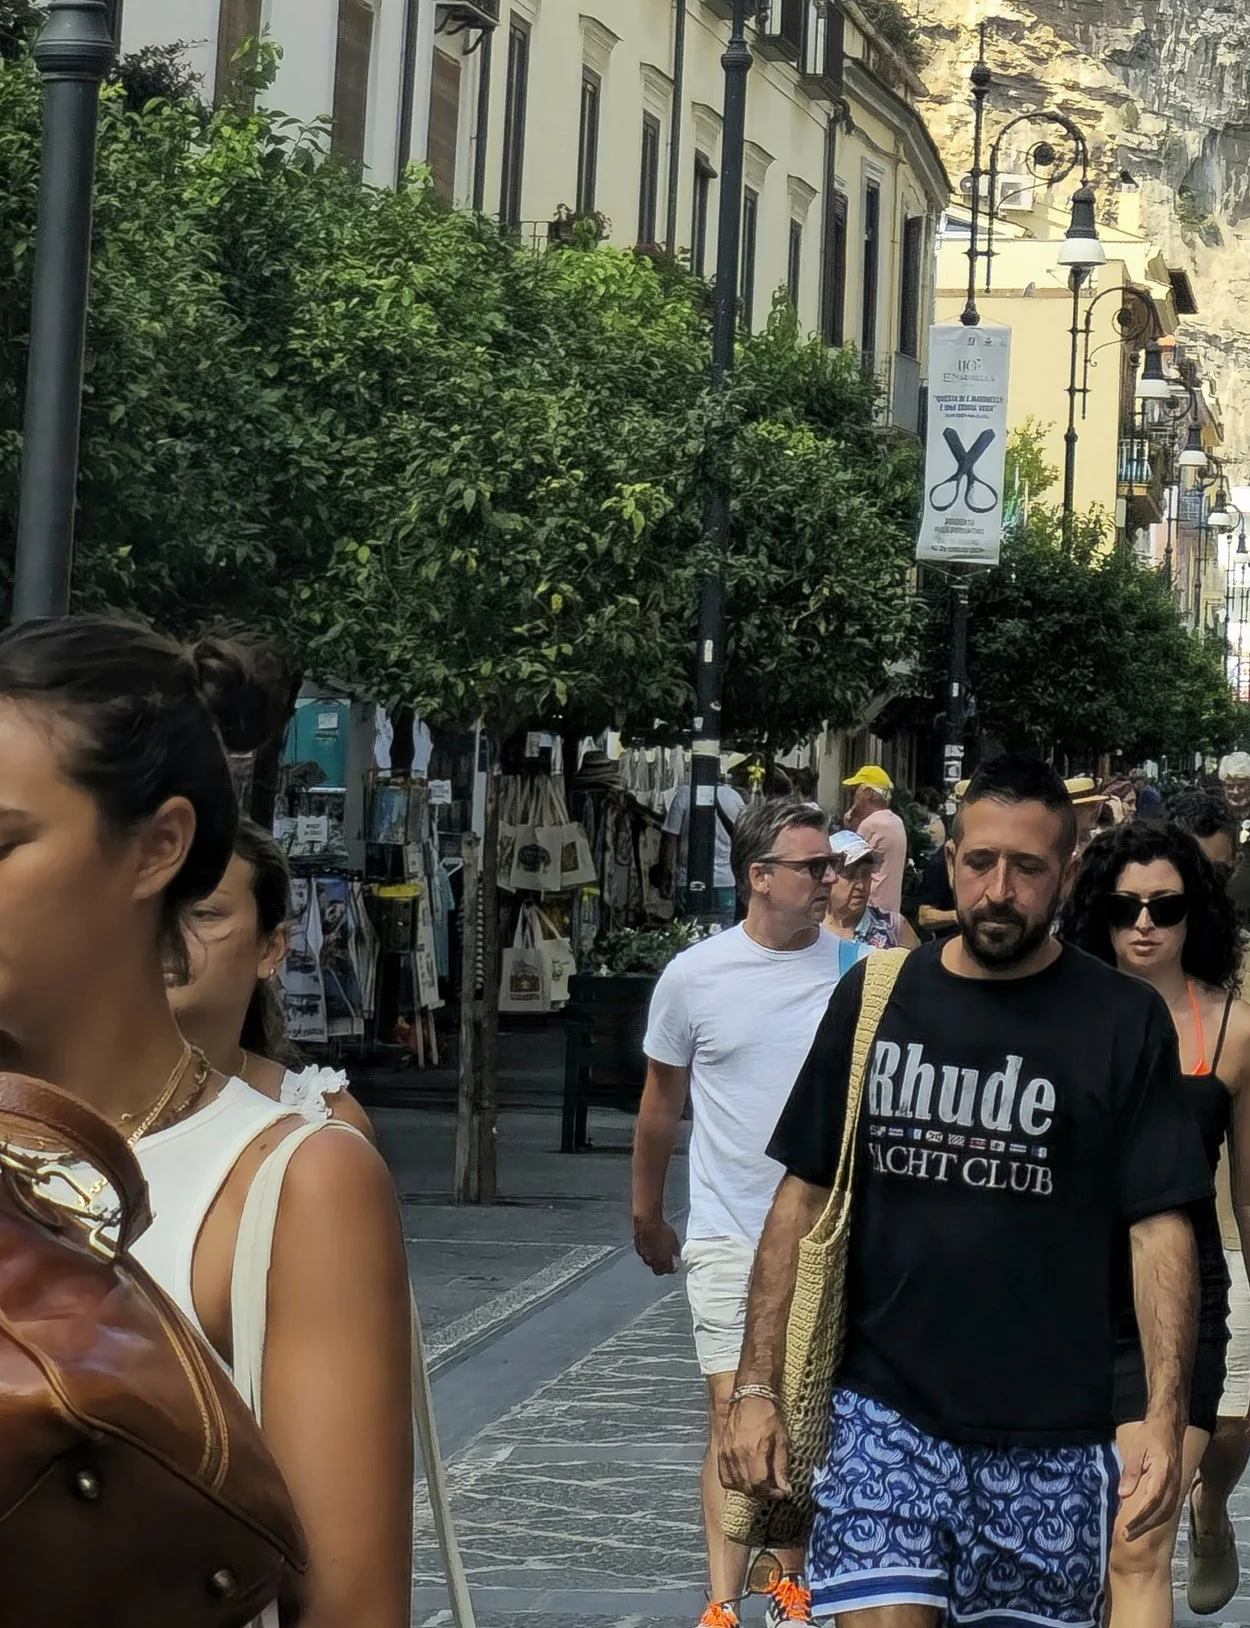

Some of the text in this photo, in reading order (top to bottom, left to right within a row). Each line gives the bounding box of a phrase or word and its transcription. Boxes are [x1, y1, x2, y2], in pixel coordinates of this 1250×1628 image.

[868, 1040, 1057, 1136] Rhude
[866, 1141, 1053, 1196] YACHT CLUB
